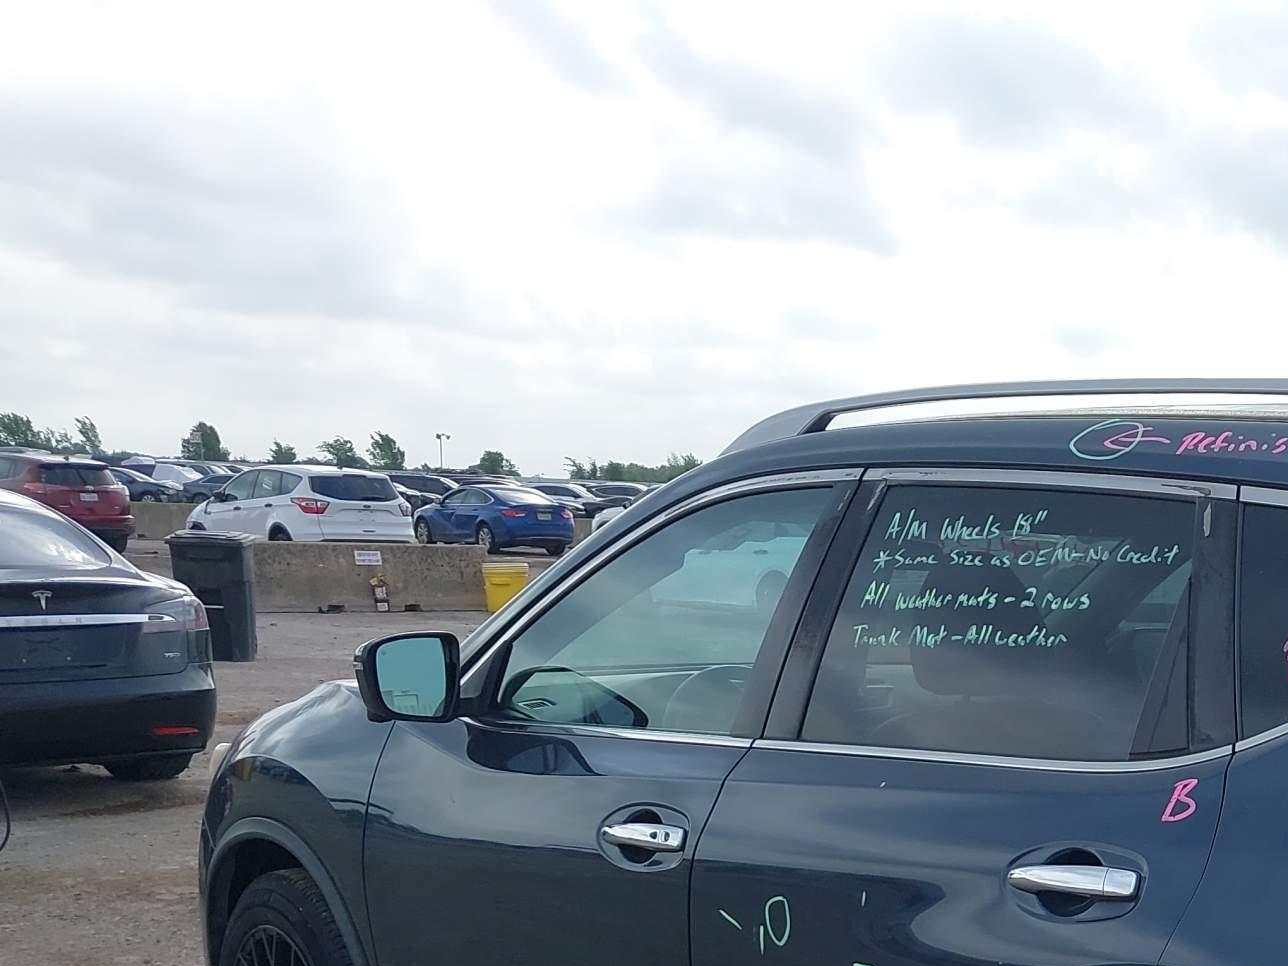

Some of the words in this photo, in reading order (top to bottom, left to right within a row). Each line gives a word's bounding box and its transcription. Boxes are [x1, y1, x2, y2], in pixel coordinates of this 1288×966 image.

[885, 509, 927, 545] A/M
[940, 514, 1001, 541] Wheels
[950, 549, 984, 566] Size
[990, 553, 1011, 568] as
[1116, 544, 1180, 565] Credit
[861, 580, 890, 609] All
[1020, 587, 1038, 608] 2
[1041, 591, 1091, 610] rows
[1161, 778, 1198, 822] B
